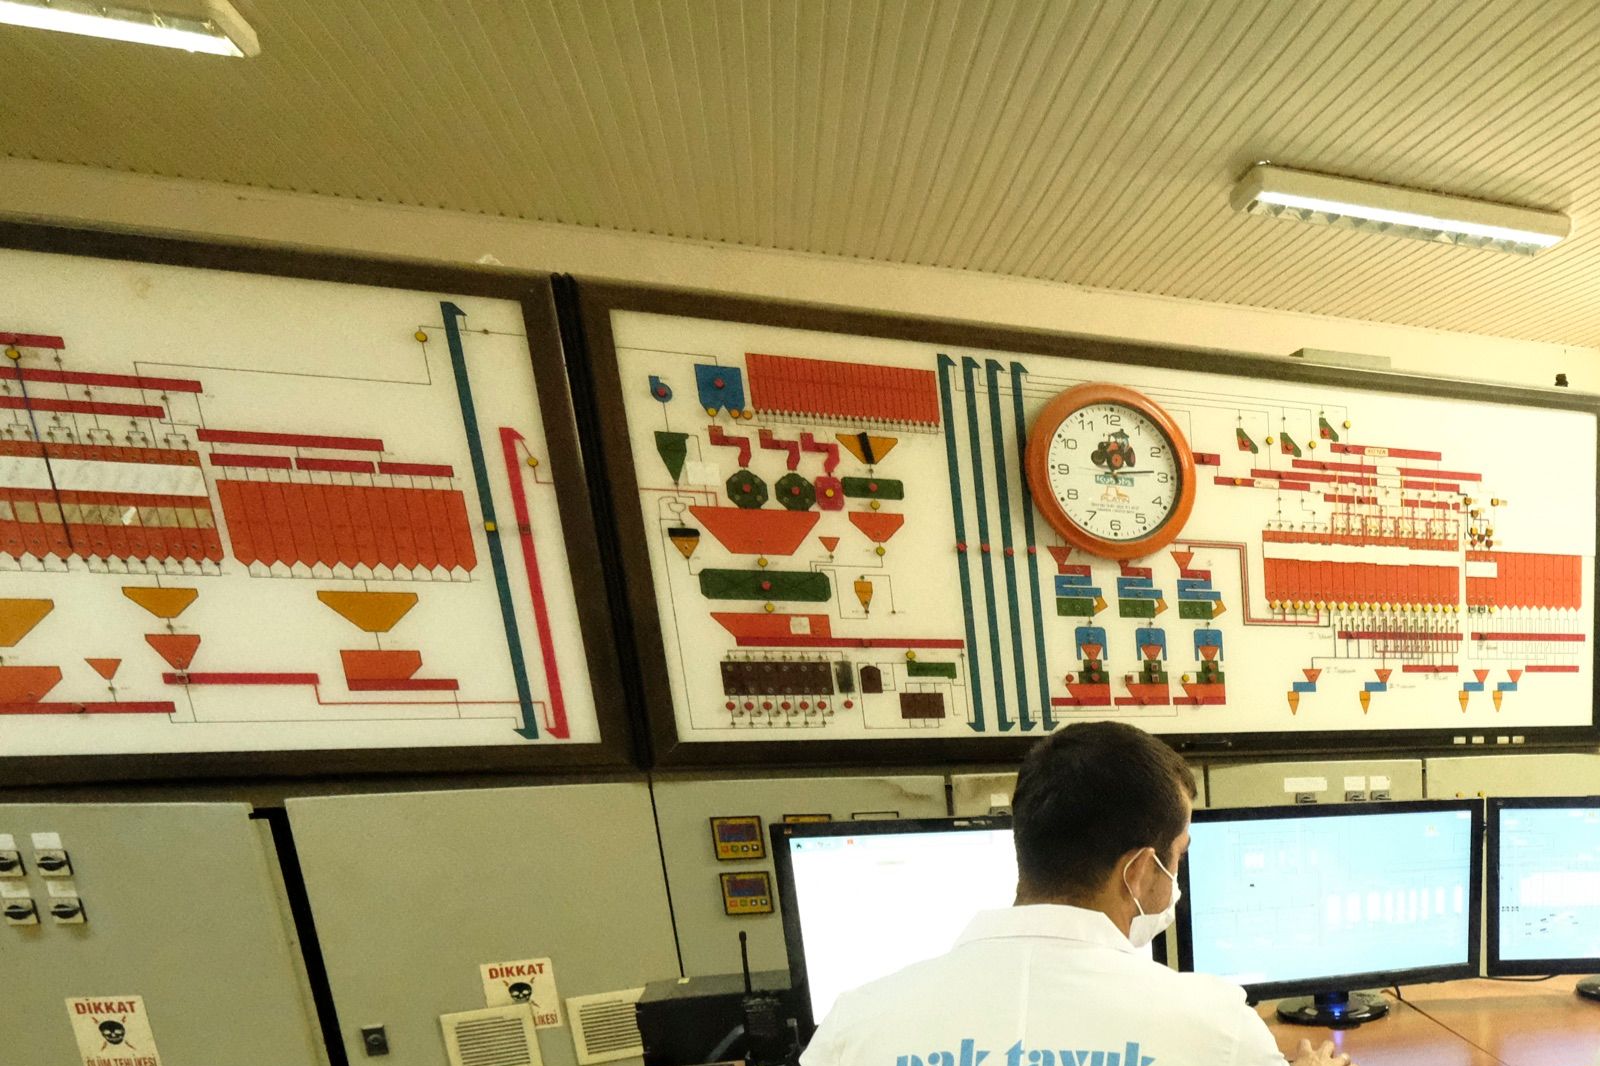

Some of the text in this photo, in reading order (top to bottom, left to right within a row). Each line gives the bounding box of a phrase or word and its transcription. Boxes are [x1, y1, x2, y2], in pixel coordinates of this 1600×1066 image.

[1078, 419, 1094, 431] 11
[1103, 414, 1121, 427] 12
[1135, 425, 1141, 436] 1
[1061, 438, 1078, 450] 10
[1150, 447, 1161, 458] 2
[1058, 464, 1069, 475] 9
[1157, 472, 1169, 484] 3
[1067, 489, 1079, 500] 8
[1152, 496, 1162, 506] 4
[1086, 510, 1097, 521] 7
[1136, 513, 1146, 524] 5
[1110, 520, 1121, 531] 6
[488, 963, 544, 979] DİKKAT
[75, 998, 136, 1014] DİKKAT
